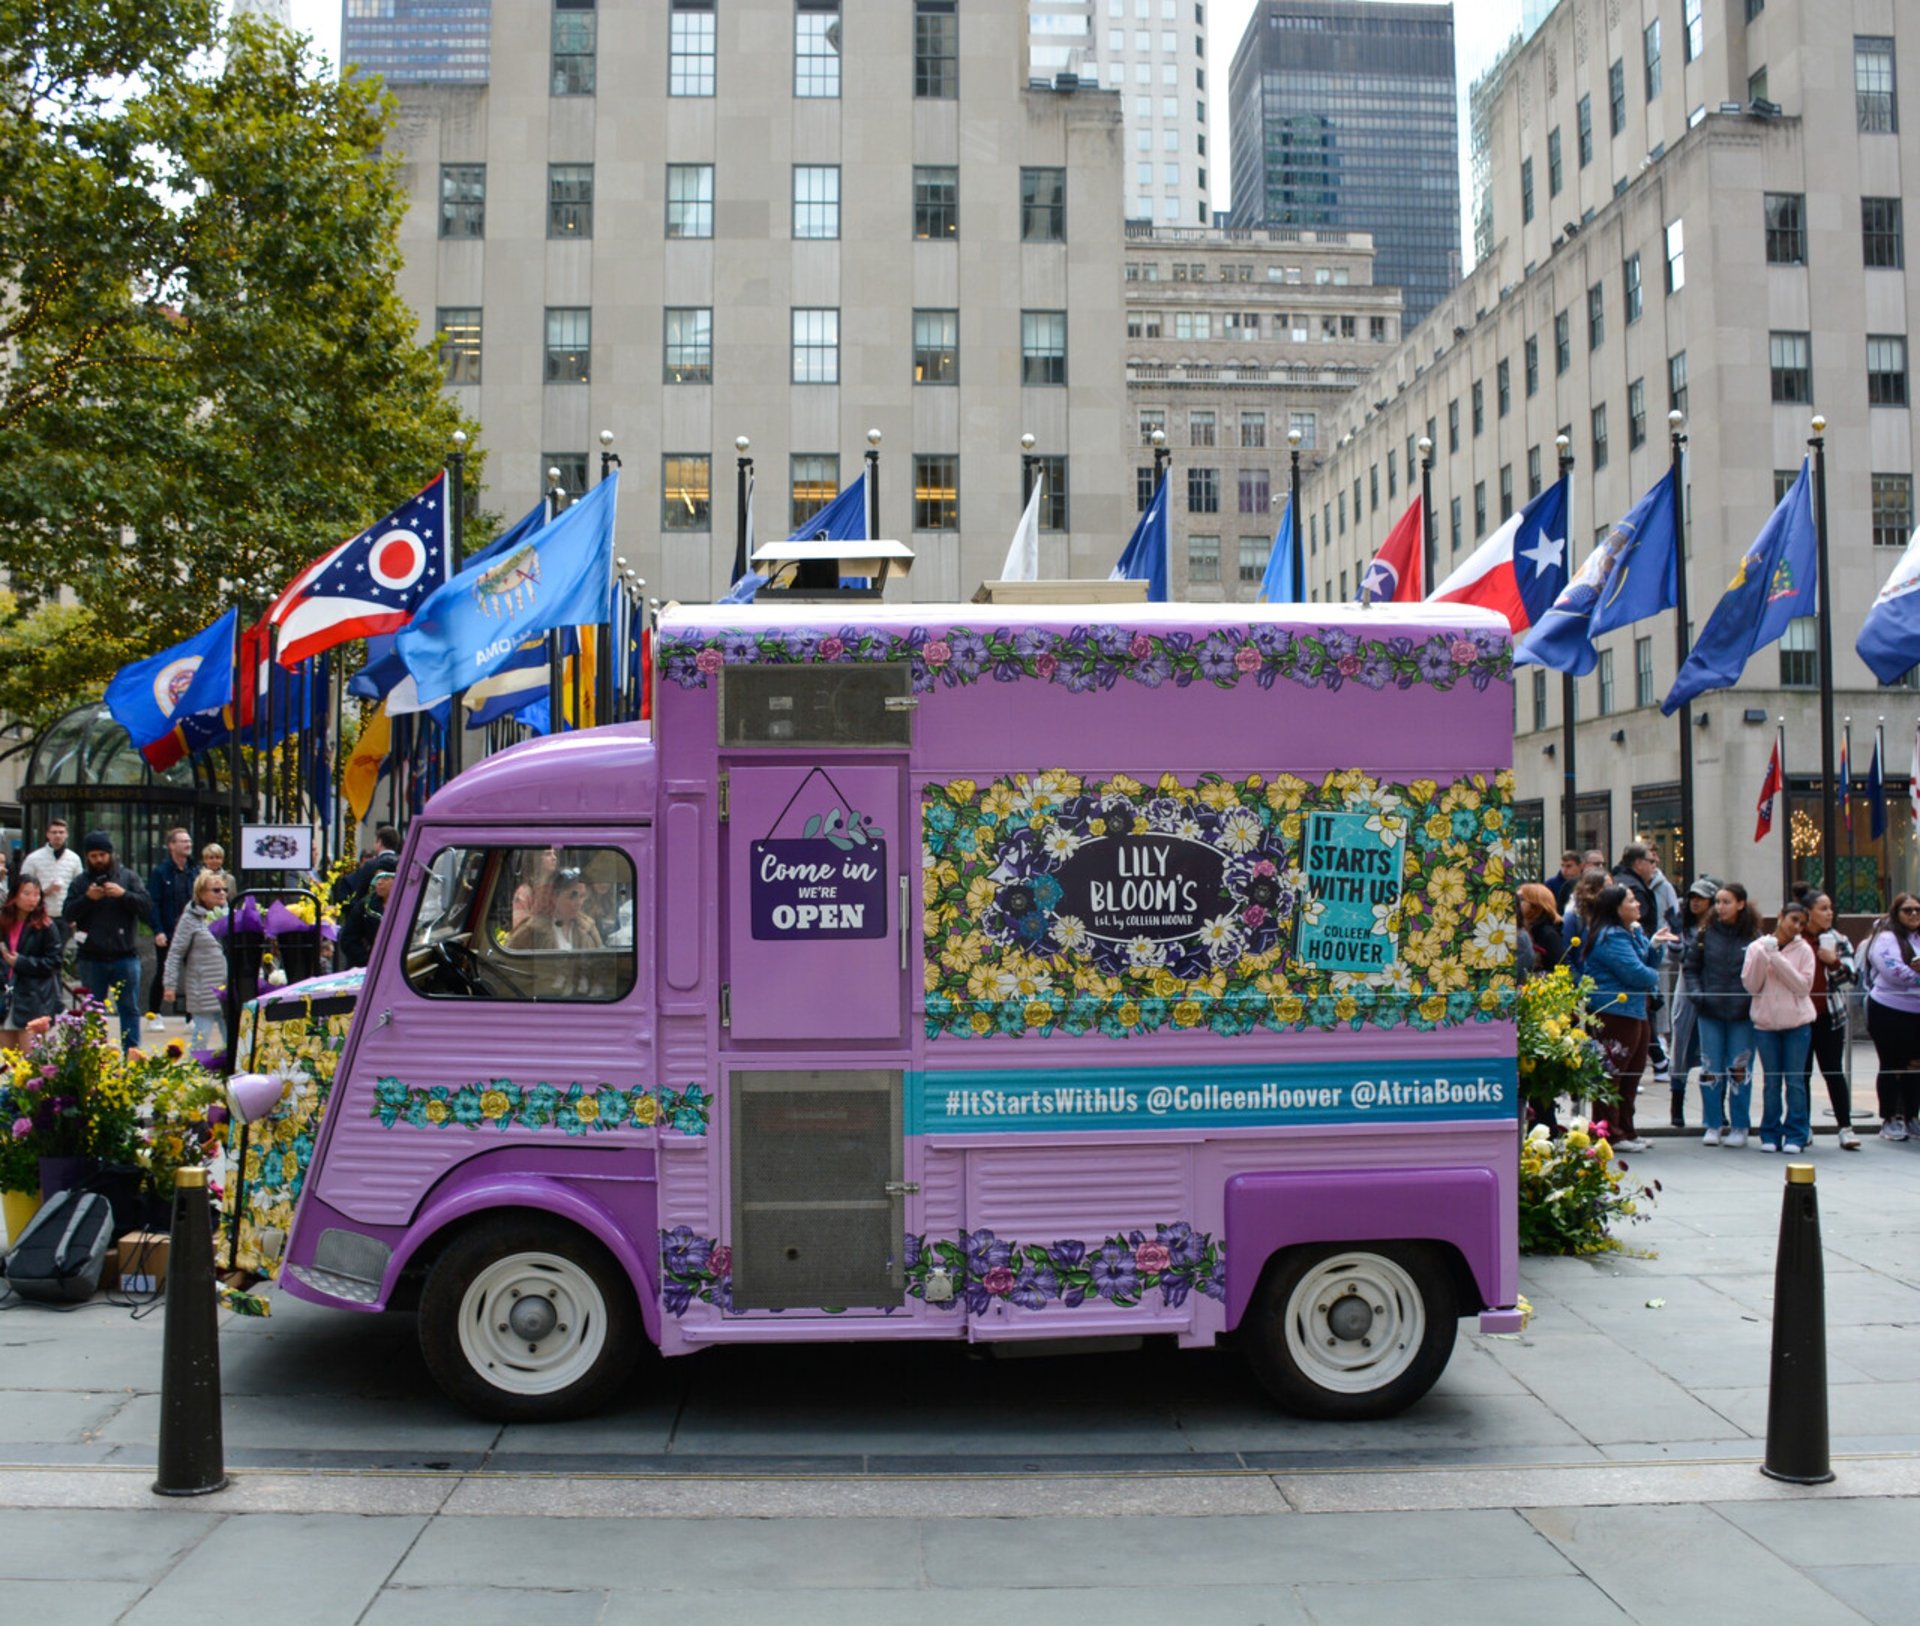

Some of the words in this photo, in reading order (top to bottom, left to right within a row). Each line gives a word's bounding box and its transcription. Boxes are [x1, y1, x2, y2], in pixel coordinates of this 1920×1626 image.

[1314, 816, 1335, 841] IT
[761, 854, 836, 883] Come
[842, 857, 877, 882] in
[1118, 845, 1170, 877] LILY
[1309, 845, 1392, 875] STARTS
[798, 886, 837, 898] WE'RE
[1090, 874, 1198, 912] BLOOM'S
[1308, 875, 1364, 903] WITH
[1370, 879, 1399, 905] US
[772, 904, 865, 929] OPEN
[1125, 914, 1160, 926] COLLEEN
[1161, 914, 1193, 926] HOOVER
[1324, 925, 1371, 940] COLLEEN
[1309, 939, 1383, 964] HOOVER
[946, 1087, 1138, 1116] #ItStartsWithUs
[1147, 1083, 1342, 1115] @ColleenHoover
[1351, 1078, 1503, 1110] @AtriaBooks
